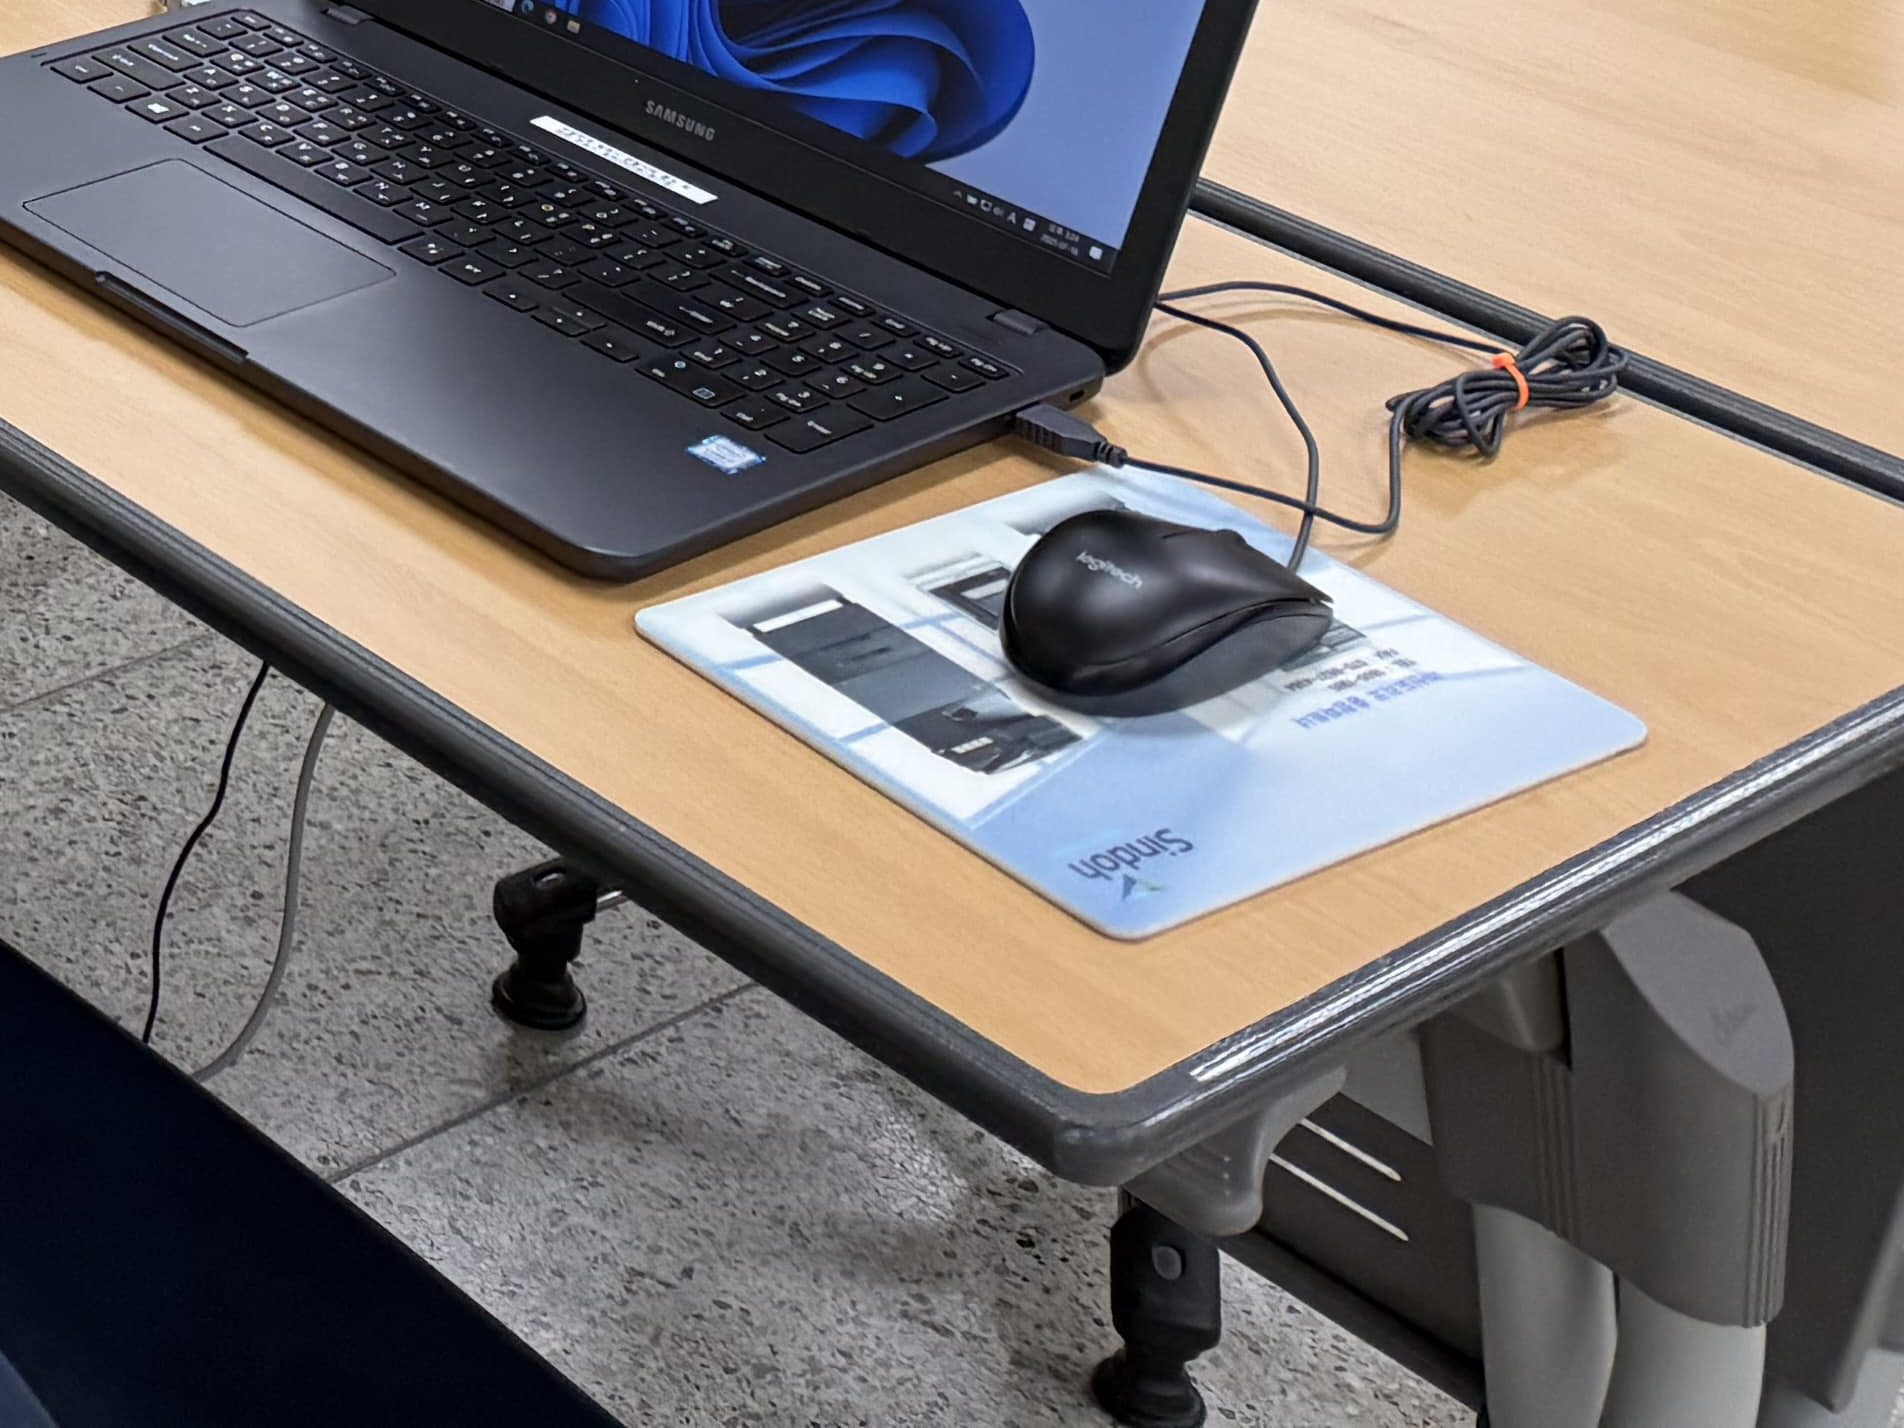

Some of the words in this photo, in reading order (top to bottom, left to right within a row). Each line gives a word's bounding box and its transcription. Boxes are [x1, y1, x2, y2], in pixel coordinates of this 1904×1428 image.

[645, 99, 716, 142] SAMSUNG
[1075, 550, 1144, 590] logitech
[1066, 828, 1194, 882] Sindoh
